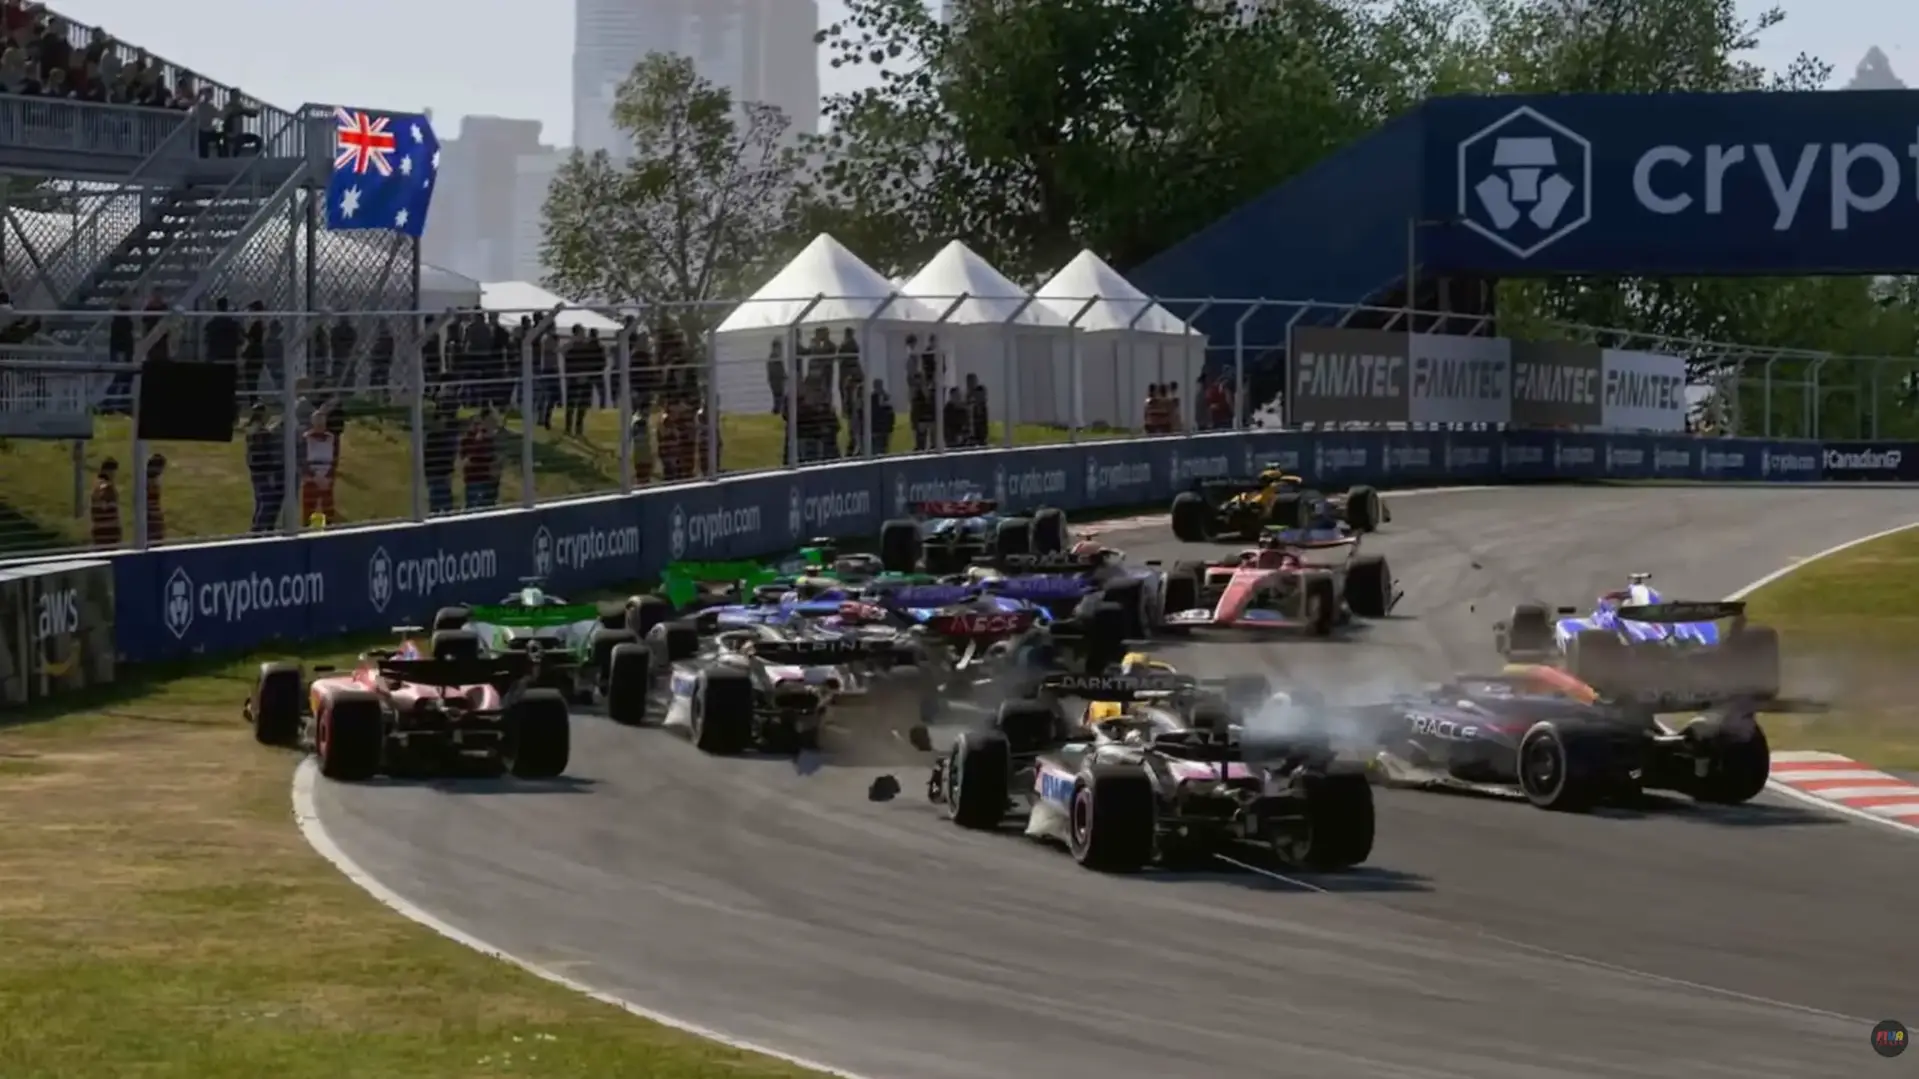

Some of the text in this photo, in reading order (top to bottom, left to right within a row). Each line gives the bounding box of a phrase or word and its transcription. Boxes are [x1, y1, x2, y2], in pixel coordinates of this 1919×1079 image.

[1297, 353, 1403, 397] FANATEC
[1413, 357, 1506, 399] FANATEC
[1514, 363, 1598, 404] FANATEC
[1605, 370, 1682, 410] FANATEC
[688, 505, 761, 547] crypto.com
[804, 489, 870, 528] crypto.com
[555, 526, 639, 567] crypto.com
[396, 548, 497, 596] crypto.com
[38, 588, 78, 640] aws
[199, 571, 325, 622] crypto.com
